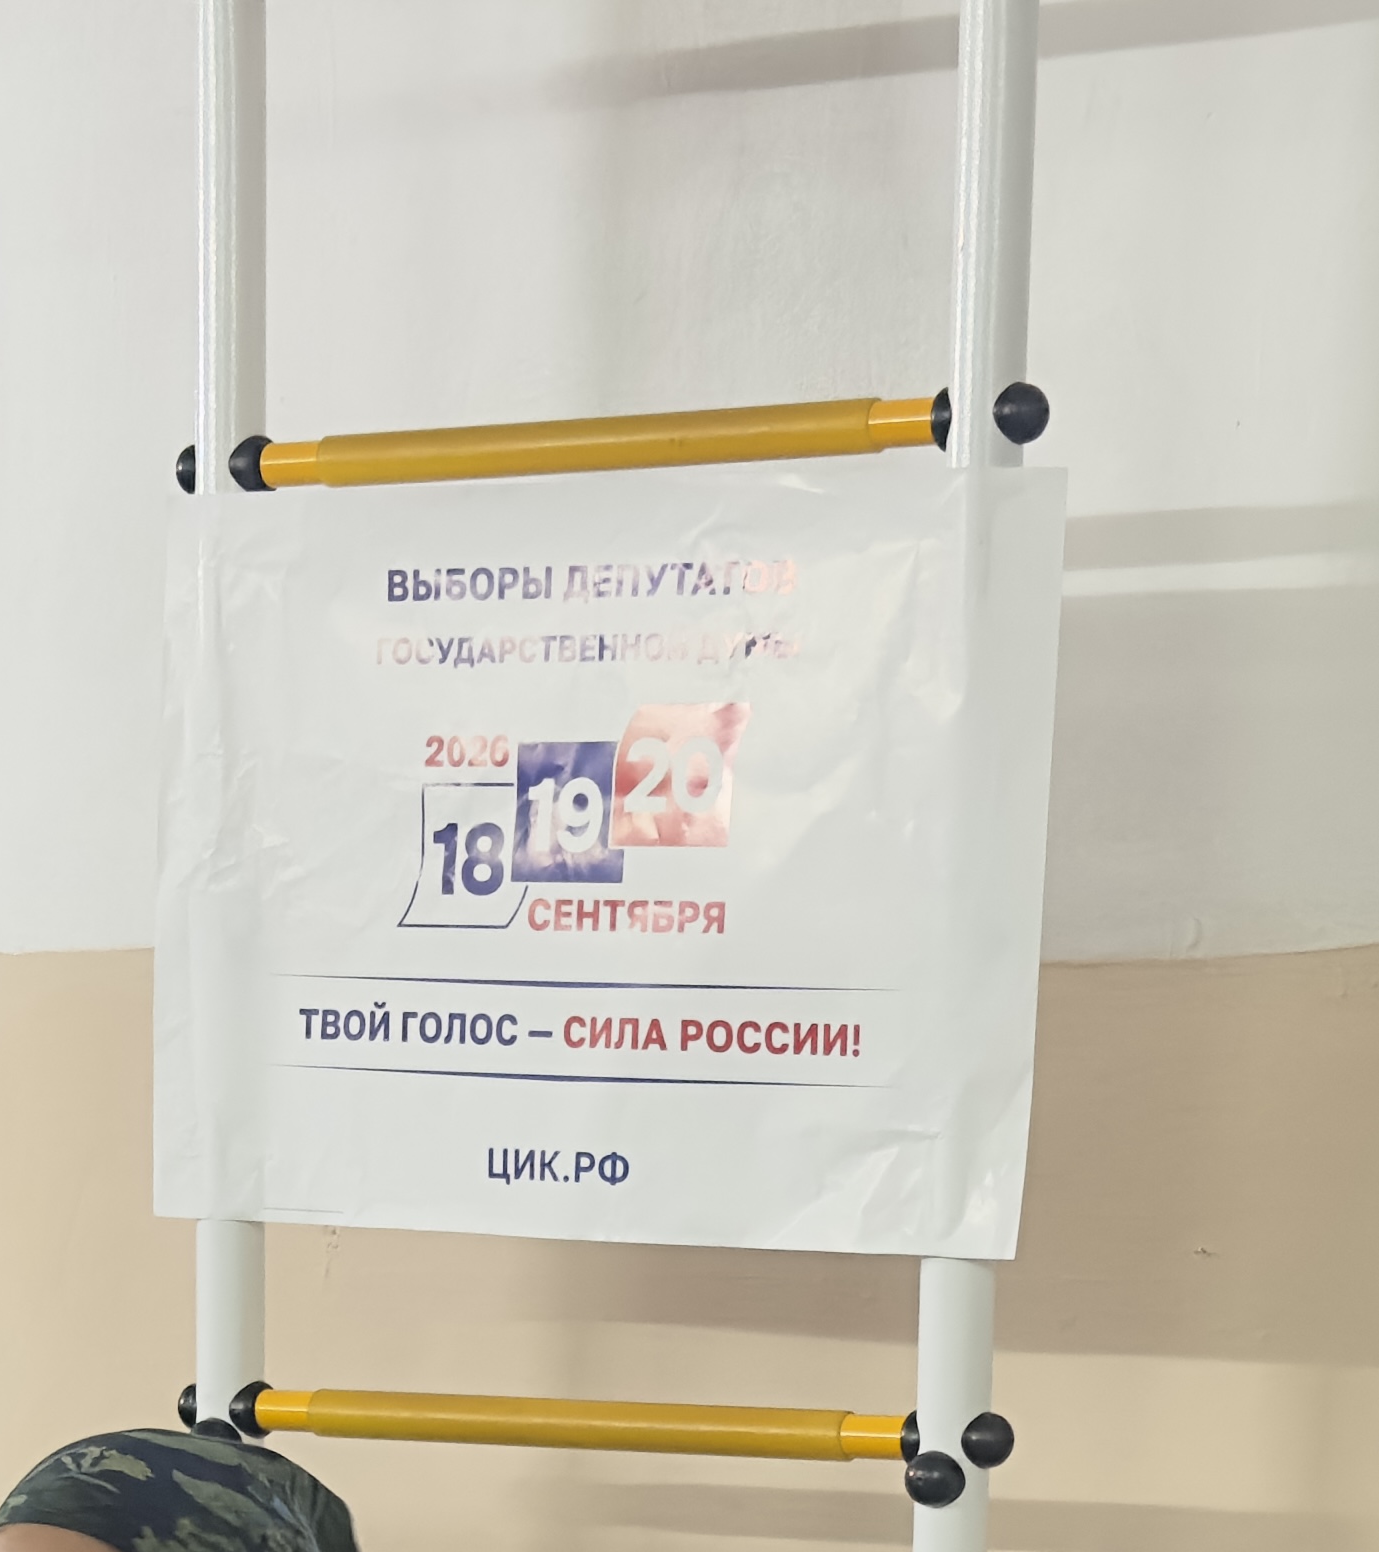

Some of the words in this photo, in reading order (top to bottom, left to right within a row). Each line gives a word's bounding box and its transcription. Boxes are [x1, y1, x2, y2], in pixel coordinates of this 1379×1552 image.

[387, 566, 552, 602] ВЫБОРЫ
[424, 735, 510, 768] 2026
[433, 822, 505, 896] 18
[528, 776, 604, 854] 19
[623, 736, 724, 814] 20
[527, 898, 727, 934] СЕНТЯБРЯ
[299, 1001, 390, 1041] ТВОЙ
[401, 1012, 518, 1046] ГОЛОС
[563, 1015, 668, 1052] СИЛА
[680, 1020, 862, 1058] РОССИИ!
[487, 1147, 631, 1186] ЦИК.РФ
